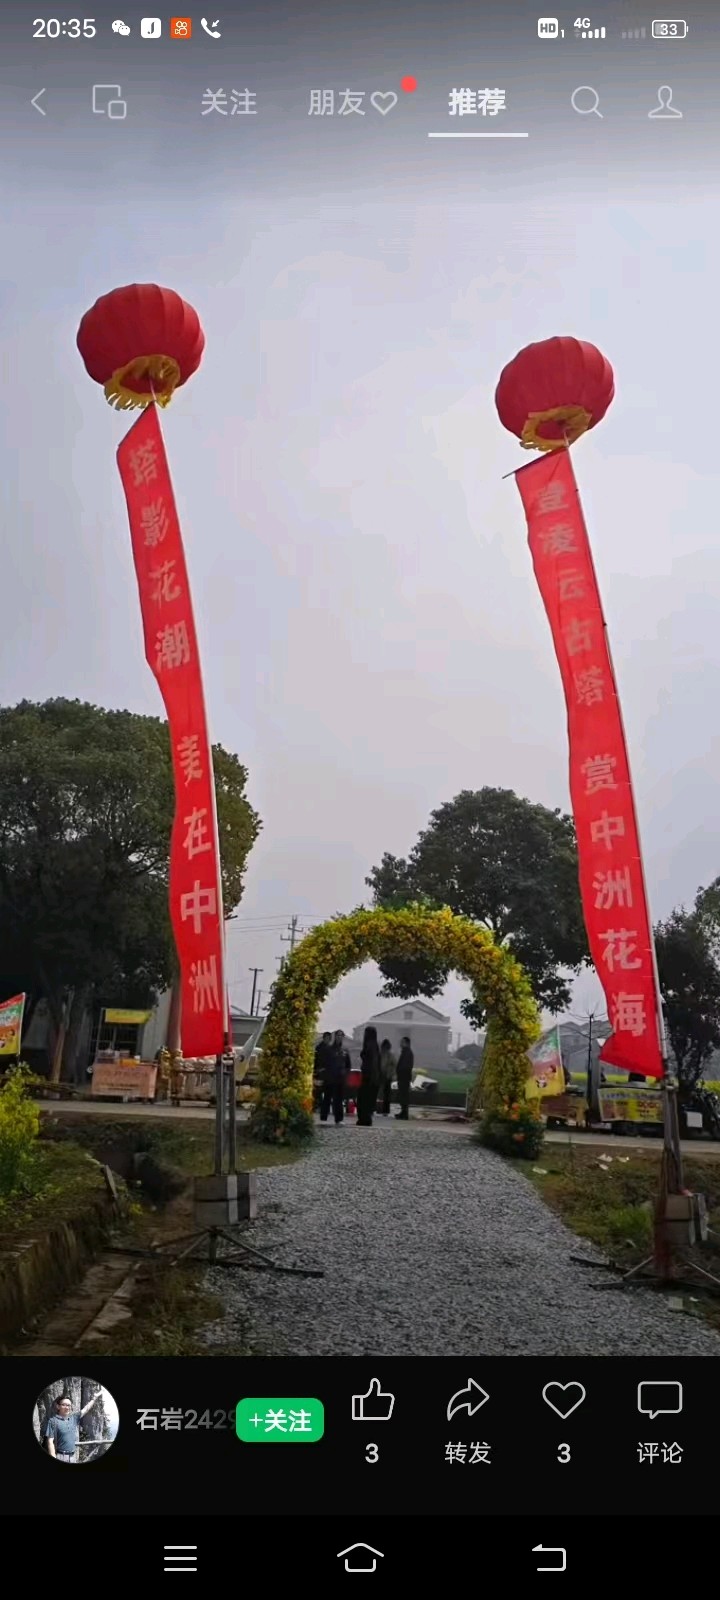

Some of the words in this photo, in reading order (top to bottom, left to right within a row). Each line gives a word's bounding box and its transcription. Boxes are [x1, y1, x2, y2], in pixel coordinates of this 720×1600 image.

[177, 734, 220, 1014] 美在中洲
[580, 753, 647, 1038] 赏中洲花海
